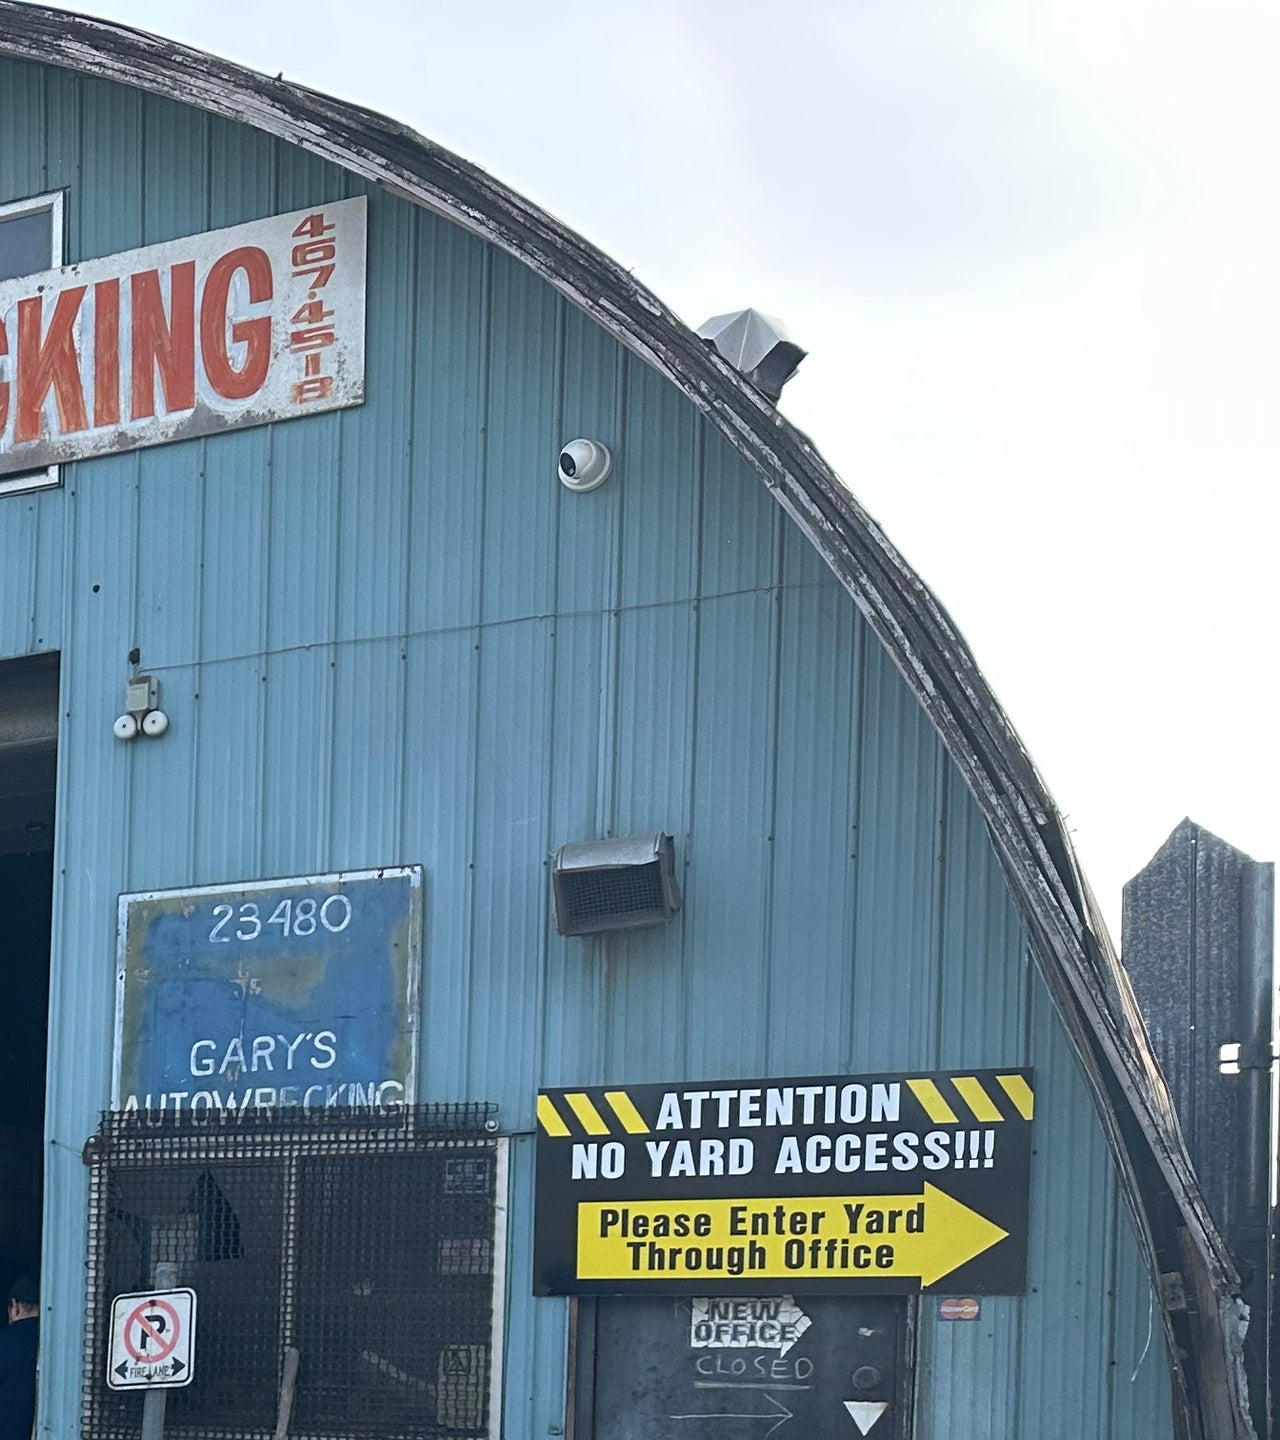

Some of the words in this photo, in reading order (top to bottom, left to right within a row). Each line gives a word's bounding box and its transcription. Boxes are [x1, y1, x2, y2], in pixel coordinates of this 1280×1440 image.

[209, 894, 352, 943] 23480
[191, 1030, 337, 1077] GARY'S
[656, 1083, 901, 1131] ATTENTION
[571, 1142, 626, 1180] NO
[645, 1138, 754, 1178] YARD
[774, 1130, 996, 1175] ACCESS!!!
[600, 1206, 712, 1239] Please
[729, 1205, 826, 1237] Enter
[843, 1202, 926, 1234] Yard
[626, 1240, 766, 1276] Through
[784, 1238, 895, 1270] Office
[708, 1301, 780, 1321] NEW
[694, 1319, 796, 1343] OFFICE
[130, 1365, 147, 1379] FIRE
[696, 1355, 814, 1379] CLOSED
